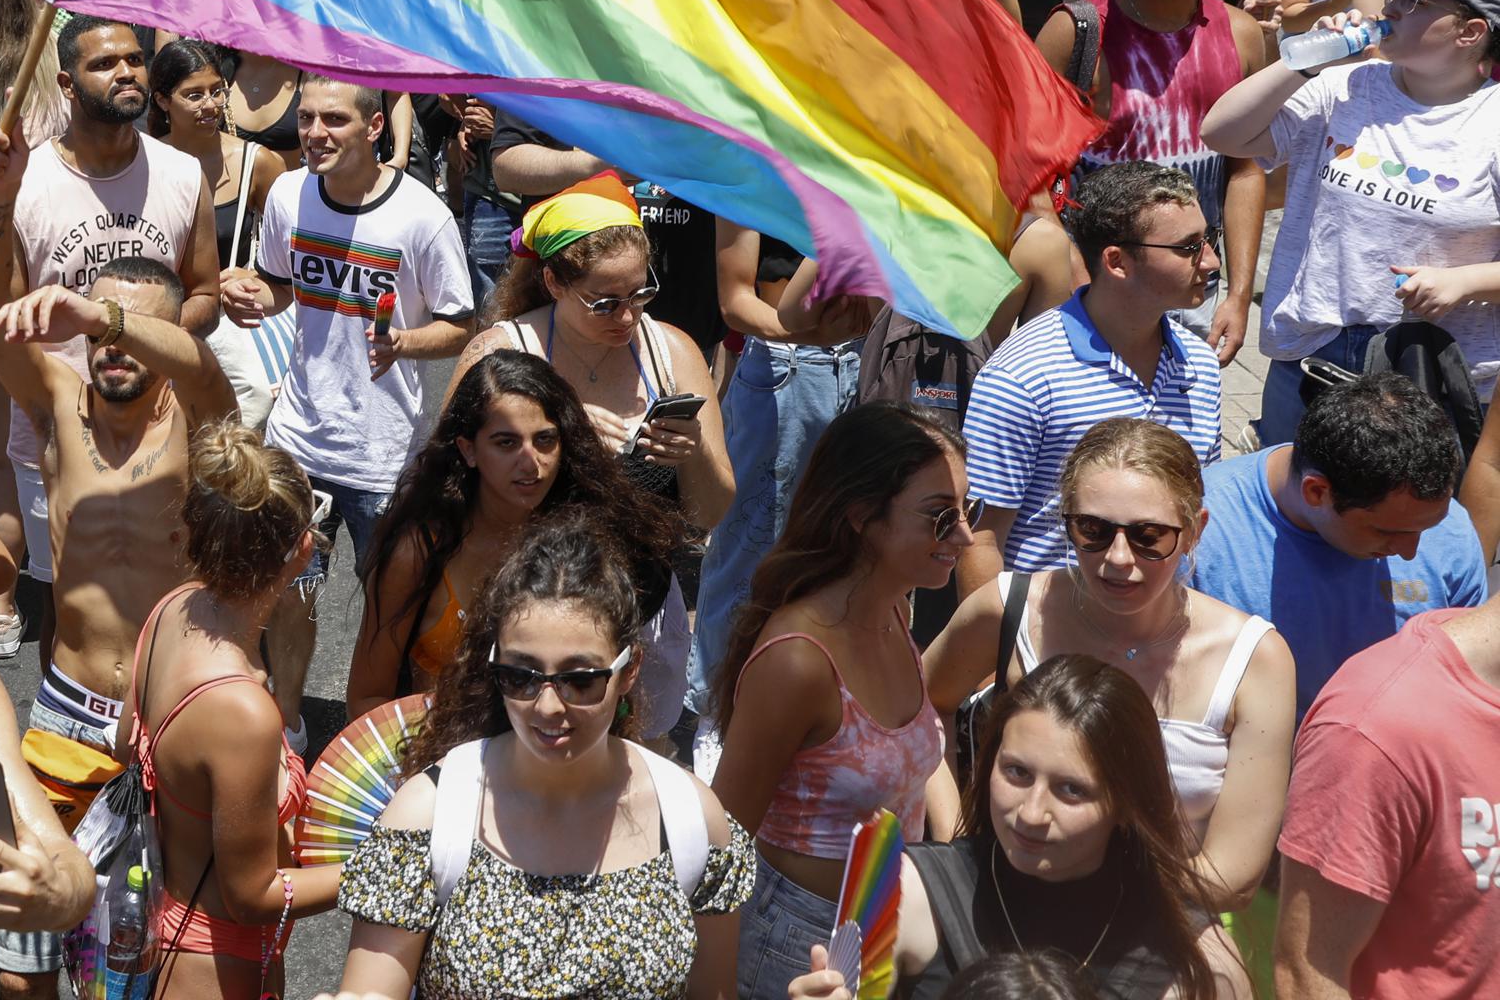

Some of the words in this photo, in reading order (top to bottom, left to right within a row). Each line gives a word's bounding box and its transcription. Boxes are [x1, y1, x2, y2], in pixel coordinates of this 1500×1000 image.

[1354, 179, 1377, 197] IS
[1383, 187, 1437, 215] LOVE
[640, 205, 691, 225] FRIEND
[51, 220, 90, 265] WEST
[95, 212, 171, 256] QUARTERS
[83, 240, 144, 265] NEVER
